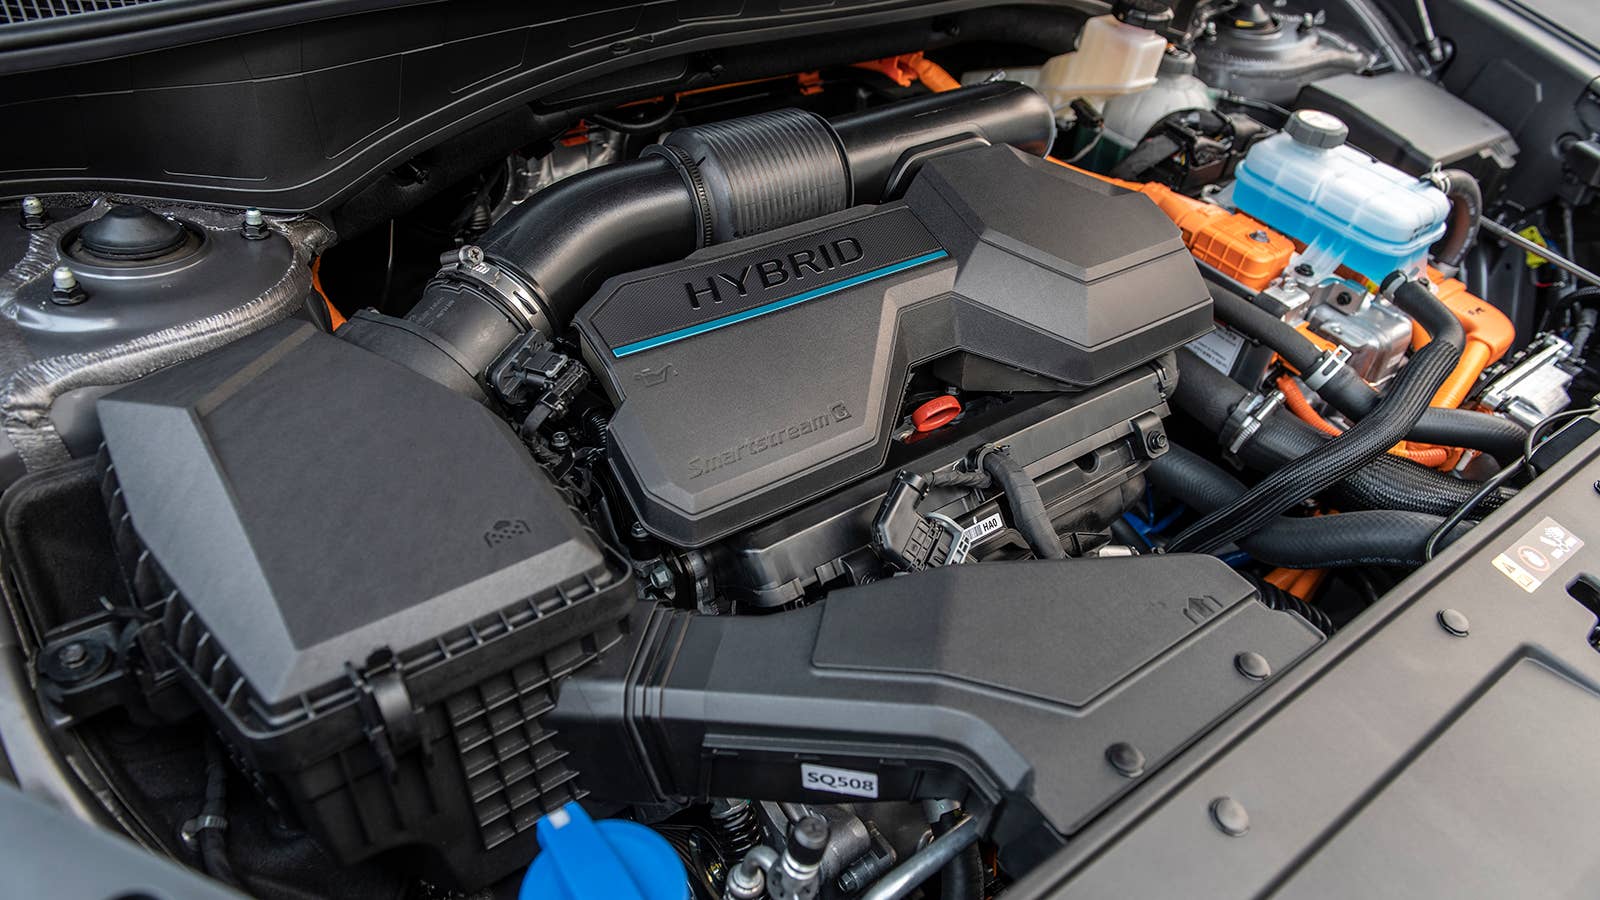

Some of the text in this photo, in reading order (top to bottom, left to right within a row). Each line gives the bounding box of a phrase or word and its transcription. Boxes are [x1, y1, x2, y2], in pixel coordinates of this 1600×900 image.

[685, 237, 865, 310] HYBRID
[688, 412, 830, 480] Smartstream
[807, 771, 874, 792] SQ508
